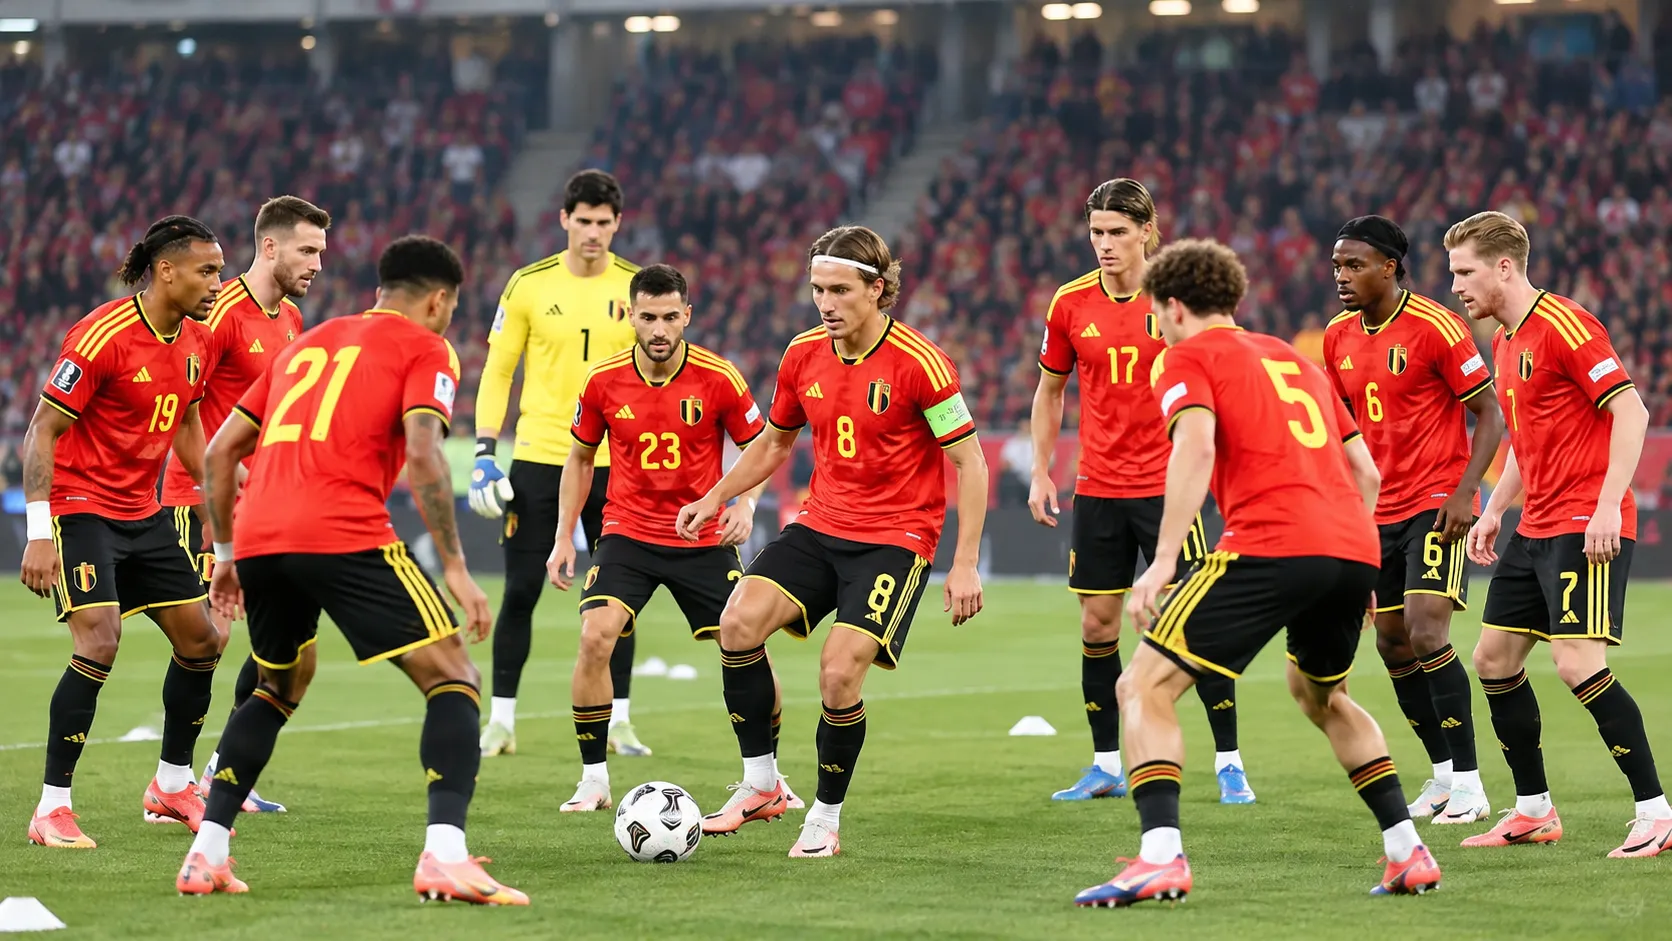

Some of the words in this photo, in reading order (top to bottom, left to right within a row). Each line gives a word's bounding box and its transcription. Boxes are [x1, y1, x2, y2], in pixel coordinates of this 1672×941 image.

[581, 328, 590, 362] 1
[1107, 346, 1139, 384] 17
[147, 393, 179, 433] 19
[262, 346, 361, 447] 21
[1261, 358, 1328, 449] 5
[1365, 382, 1384, 422] 6
[1506, 388, 1519, 432] 7
[639, 432, 681, 470] 23
[837, 415, 857, 458] 8
[1423, 531, 1443, 567] 6
[867, 573, 896, 613] 8
[1559, 571, 1579, 611] 7
